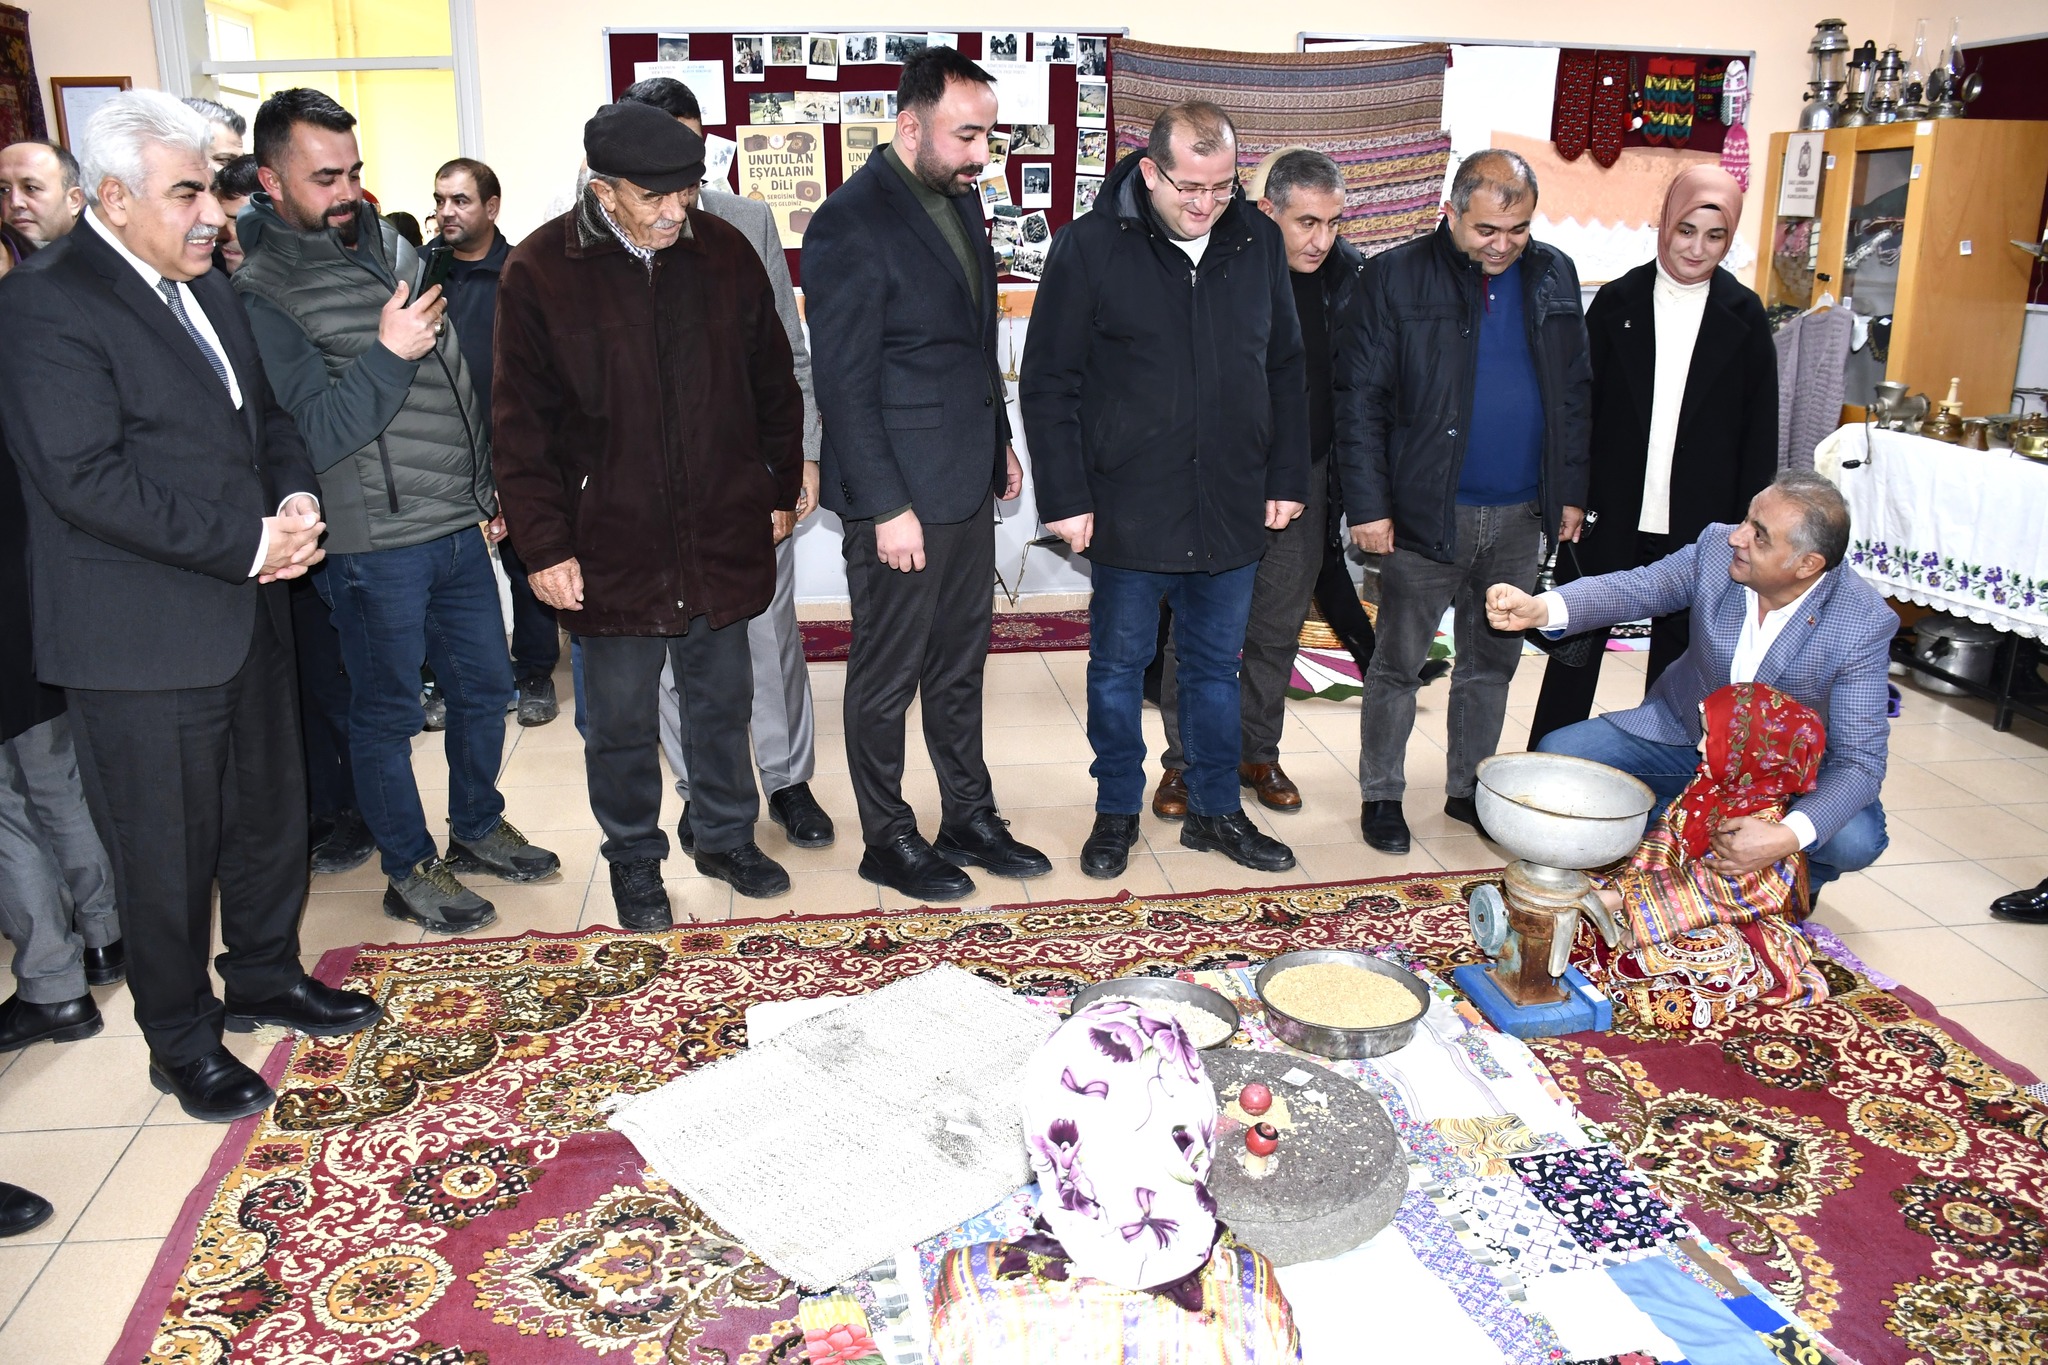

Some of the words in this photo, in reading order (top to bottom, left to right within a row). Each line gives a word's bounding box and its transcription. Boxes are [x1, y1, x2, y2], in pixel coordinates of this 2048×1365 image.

[748, 153, 814, 165] UNUTULAN
[749, 166, 814, 180] EŞYALARIN
[771, 179, 793, 191] DİLİ
